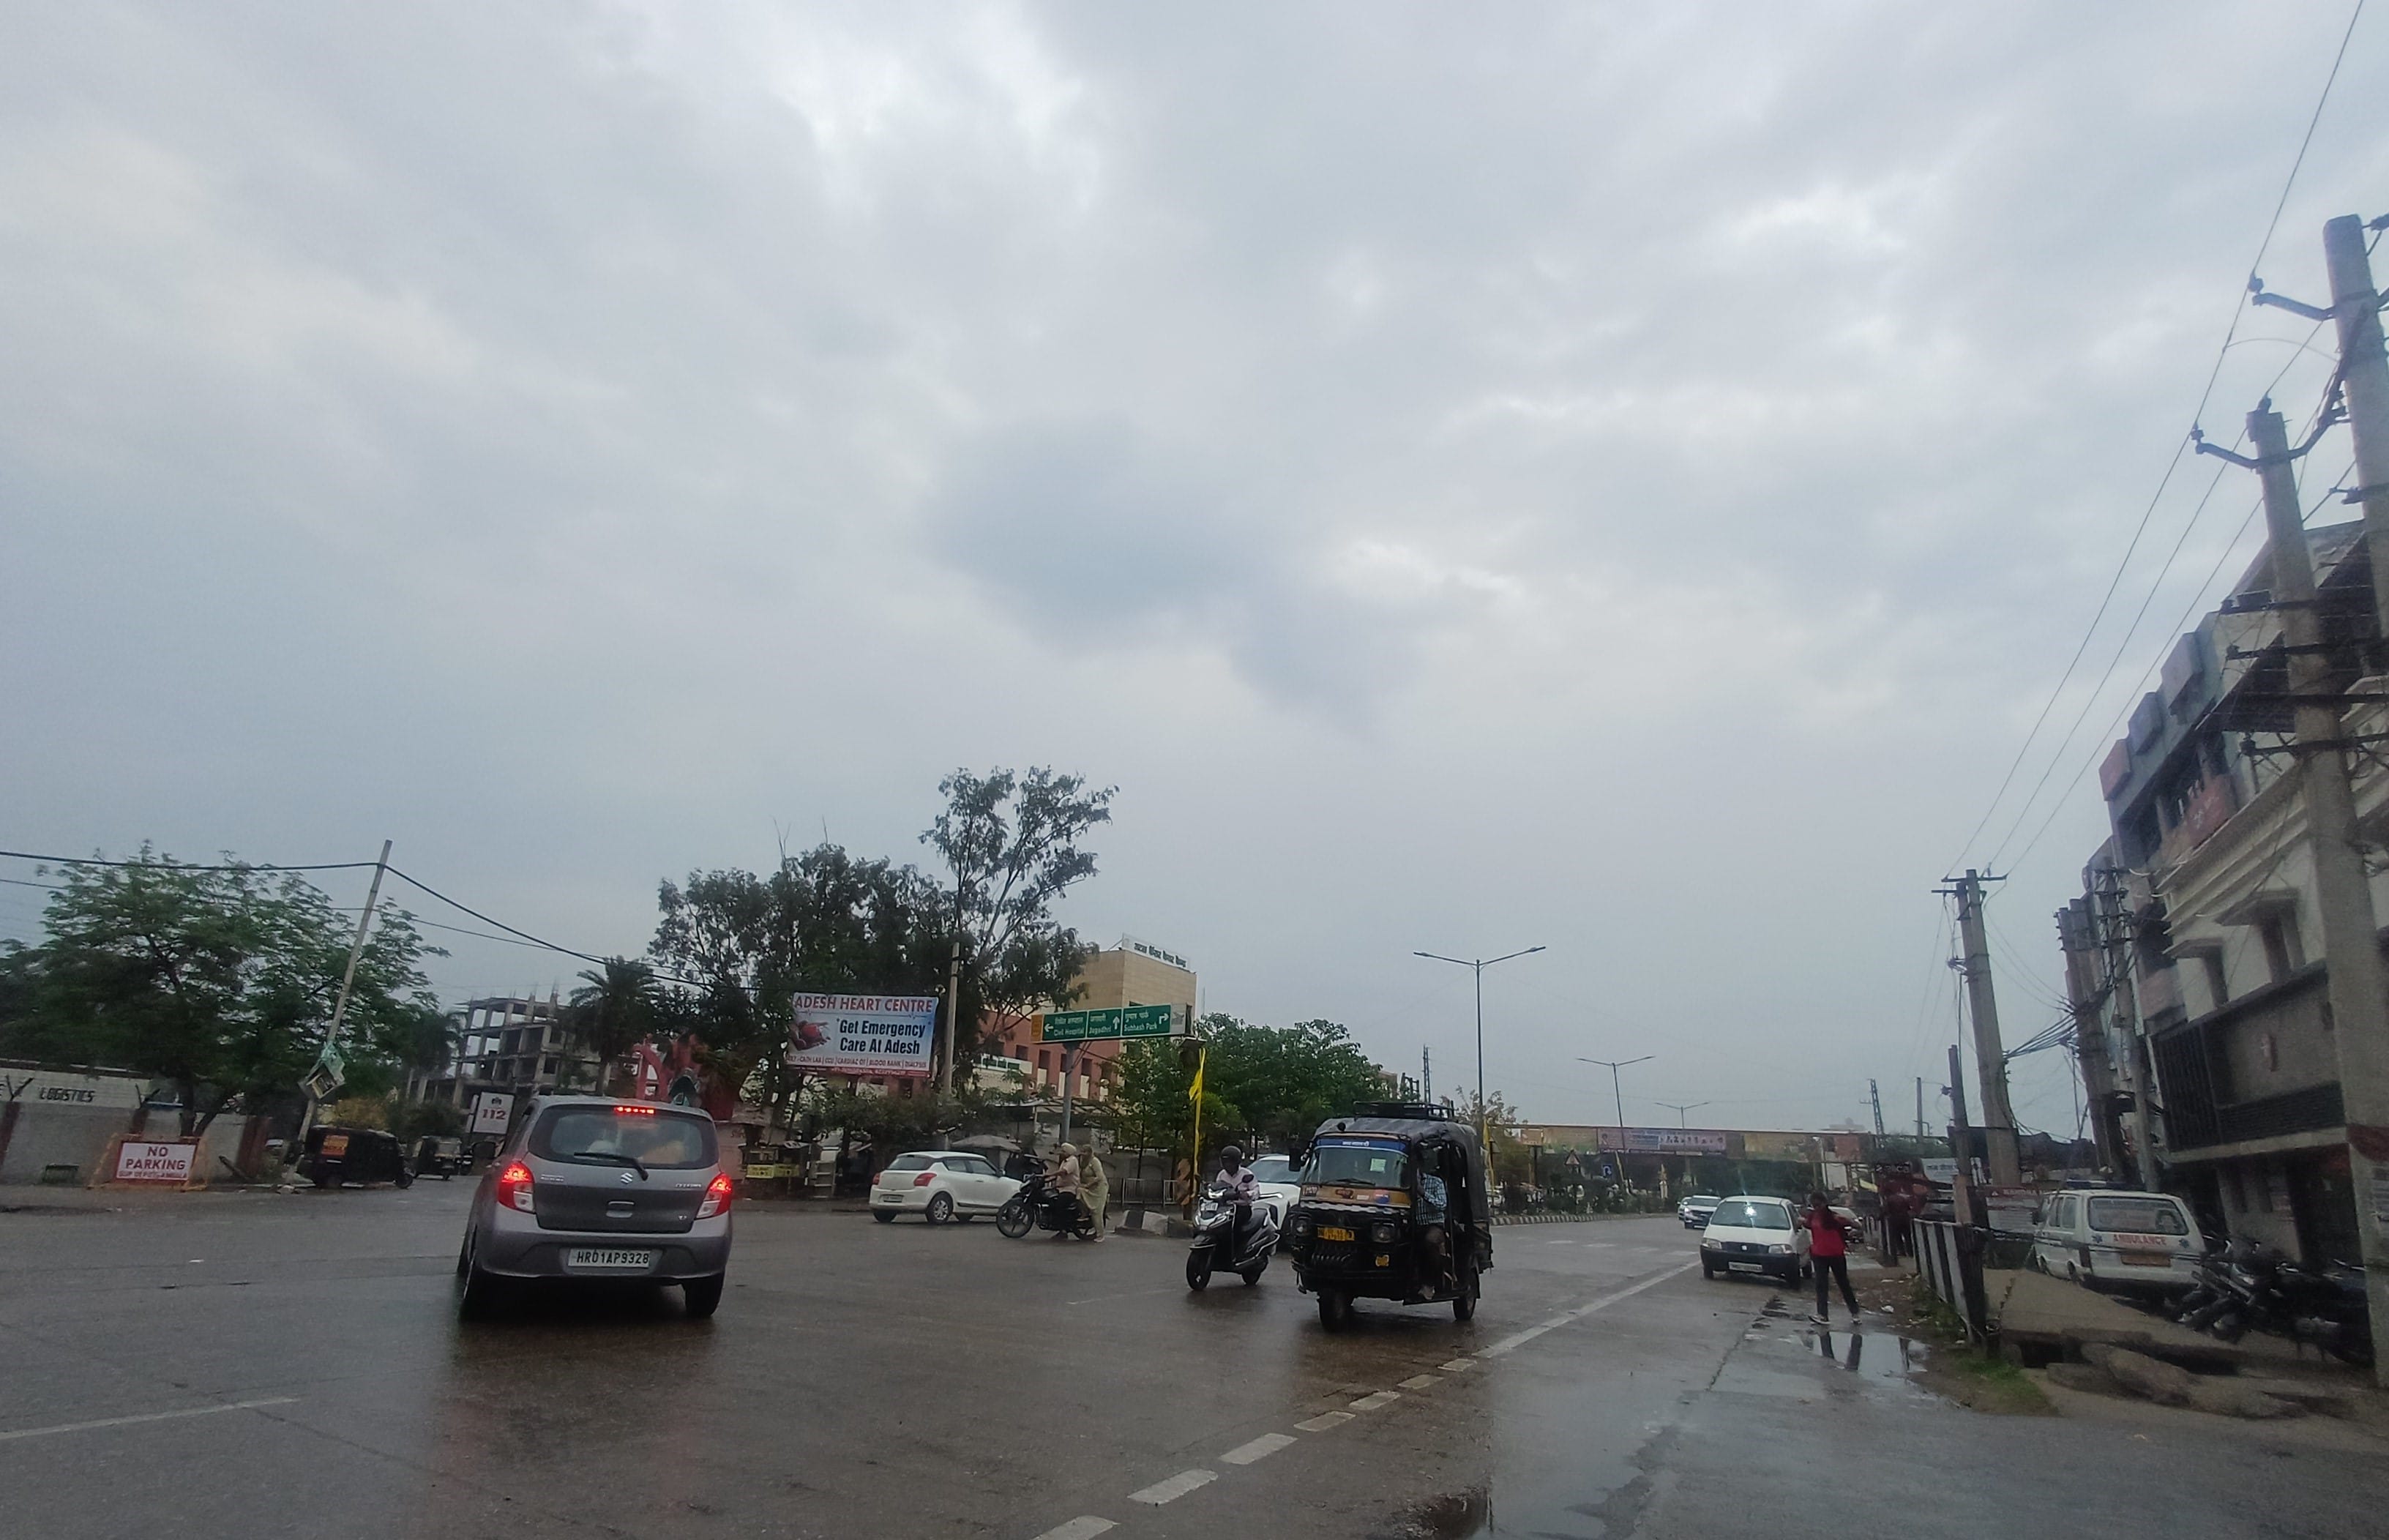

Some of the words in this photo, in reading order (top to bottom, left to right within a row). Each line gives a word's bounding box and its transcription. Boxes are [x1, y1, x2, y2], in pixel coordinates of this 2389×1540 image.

[794, 996, 836, 1009] ADESH
[840, 998, 881, 1011] HEART
[884, 999, 932, 1012] CENTRE
[840, 1020, 859, 1034] Get
[861, 1021, 925, 1038] Emergency
[840, 1037, 866, 1052] Care
[870, 1039, 881, 1053] At
[884, 1039, 920, 1054] Adesh
[40, 1088, 95, 1102] LOGISTICS
[482, 1108, 506, 1121] 112
[147, 1146, 168, 1156] NO
[126, 1159, 186, 1170] PARKING
[577, 1251, 649, 1264] HR01AP9328
